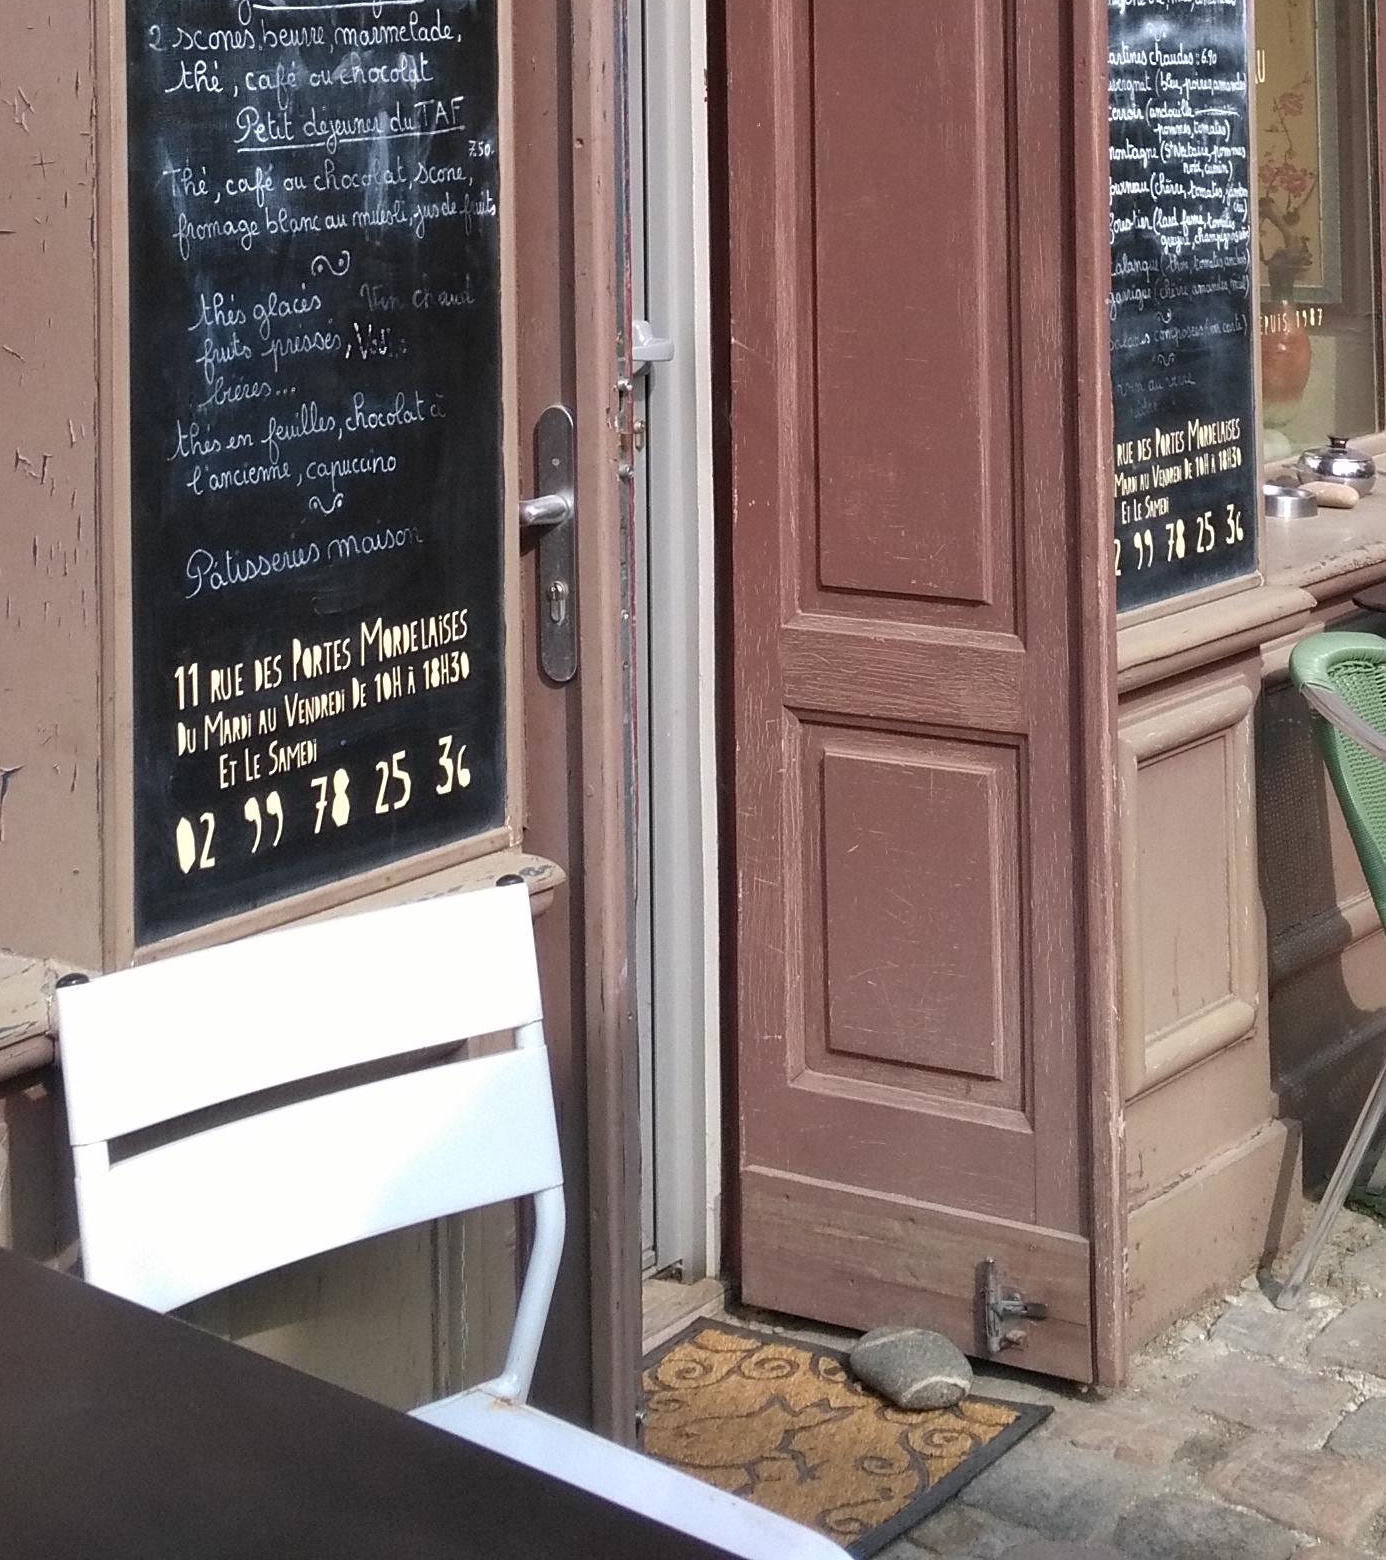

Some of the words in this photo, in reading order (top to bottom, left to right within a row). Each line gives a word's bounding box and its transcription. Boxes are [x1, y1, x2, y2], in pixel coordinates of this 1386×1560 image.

[149, 25, 163, 52] 2
[245, 62, 297, 109] café
[309, 70, 333, 86] ou
[340, 51, 433, 91] chocolat
[233, 105, 295, 144] Petit
[390, 111, 414, 133] du
[414, 95, 465, 128] TAF
[226, 165, 275, 208] café
[283, 173, 308, 191] ou
[172, 213, 261, 261] fromage
[265, 206, 322, 234] blanc
[326, 212, 348, 231] au
[441, 196, 458, 216] de
[188, 292, 247, 331] thés
[253, 282, 322, 340] glacés
[196, 335, 252, 385] fruits
[167, 419, 222, 462] thés
[226, 431, 255, 450] en
[345, 390, 425, 433] chocolat
[306, 448, 398, 493] capuccino
[327, 517, 424, 563] maison
[1133, 528, 1154, 570] 99
[1165, 518, 1186, 562] 78
[1196, 510, 1215, 554] 25
[1225, 503, 1244, 545] 36
[174, 661, 200, 711] 11
[175, 810, 216, 875] 02
[244, 790, 285, 855] 99
[310, 767, 351, 835] 78
[374, 749, 413, 815] 25
[435, 734, 472, 796] 36
